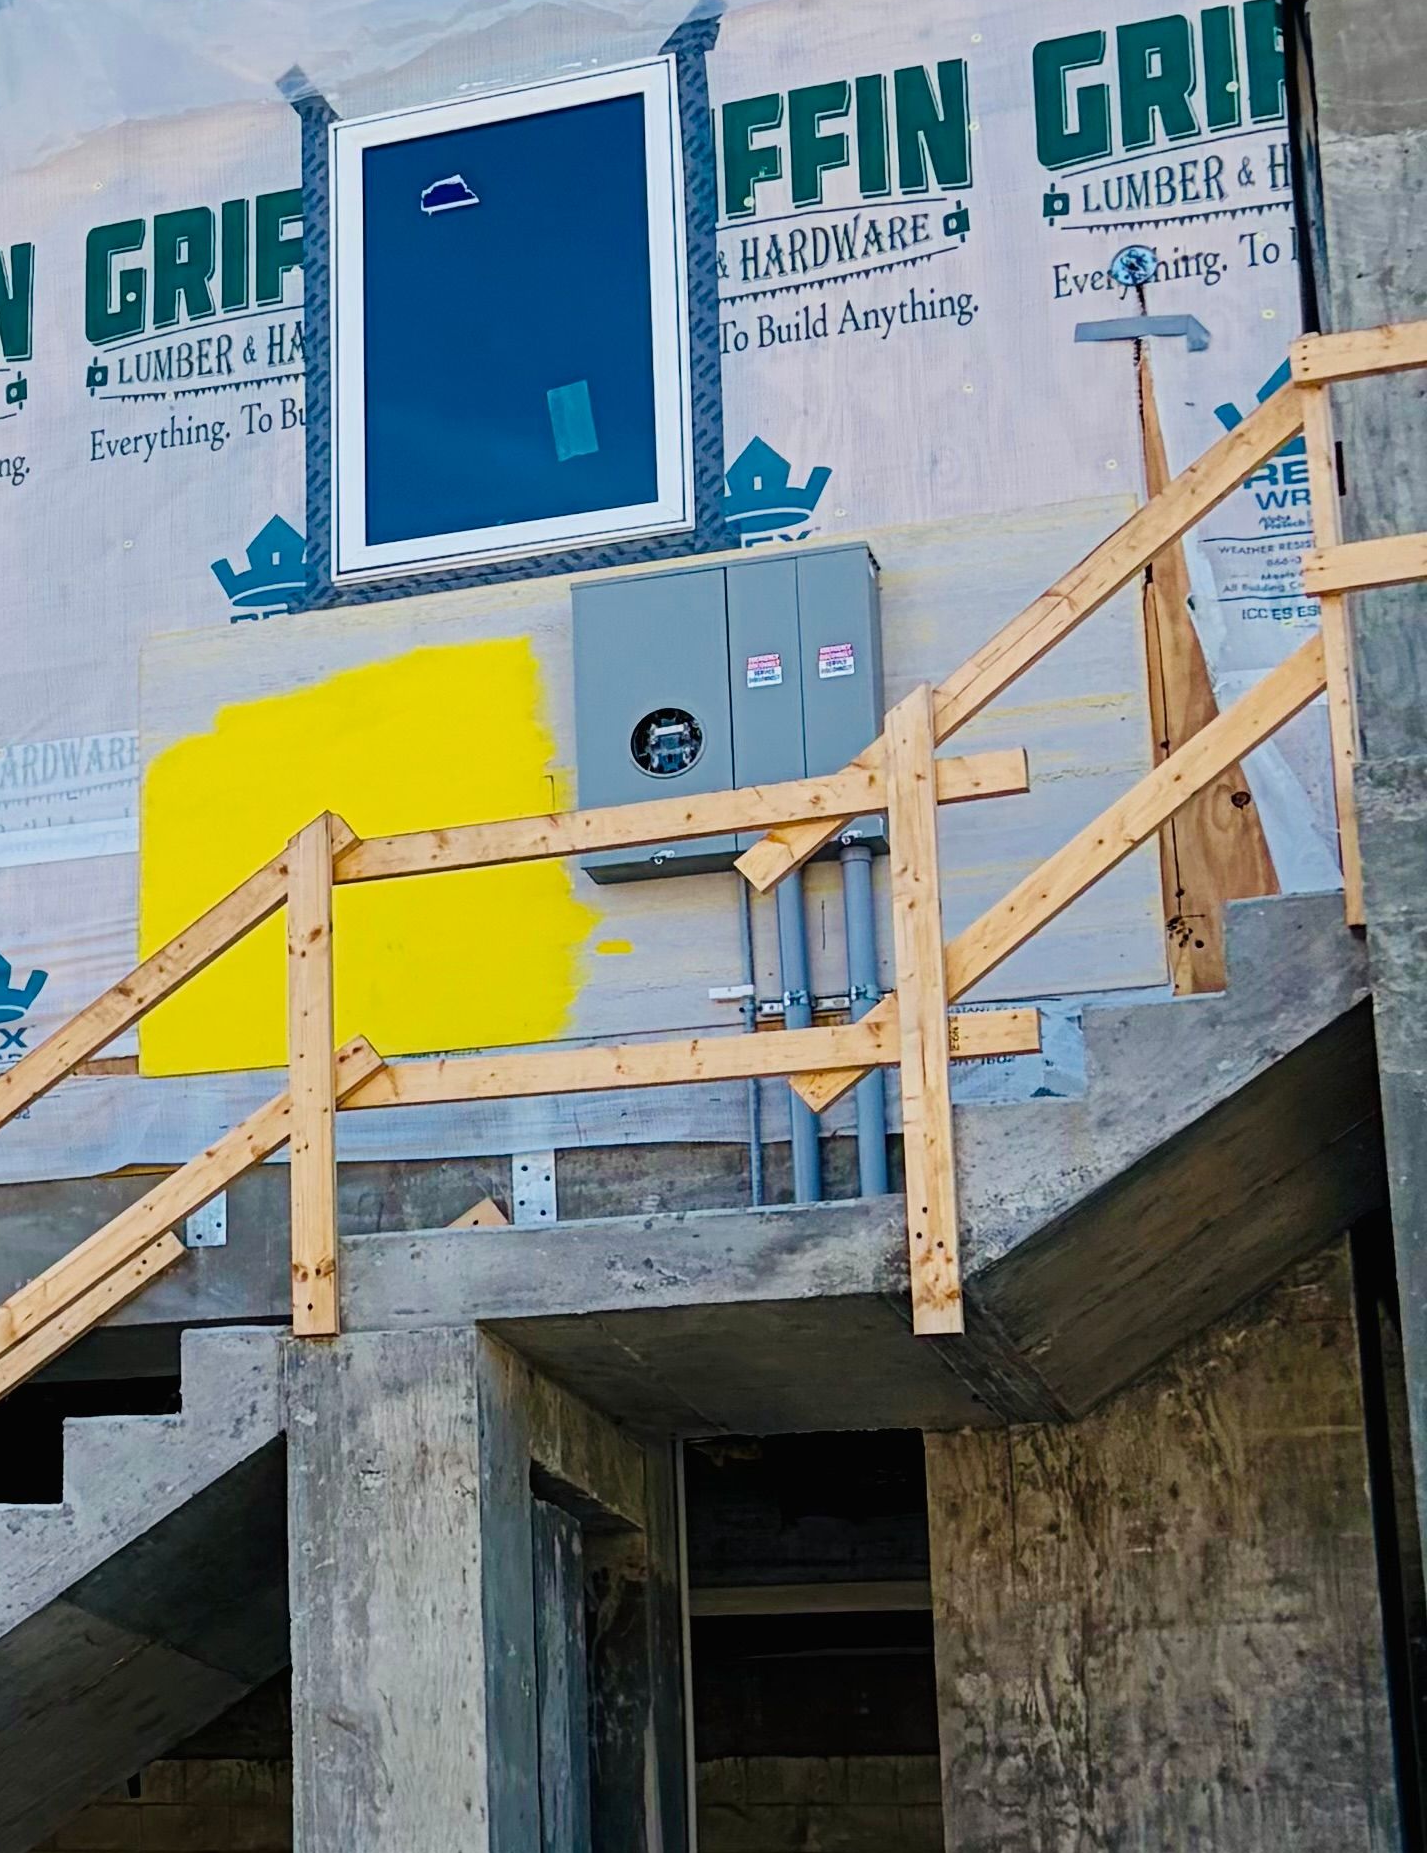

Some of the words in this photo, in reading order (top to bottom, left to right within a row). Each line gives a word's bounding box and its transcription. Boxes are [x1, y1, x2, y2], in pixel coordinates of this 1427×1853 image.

[721, 58, 973, 220] FFIN
[1082, 155, 1226, 215] LUMBER
[84, 188, 305, 346] GRIF
[739, 210, 931, 284] HARDWARE
[1053, 250, 1229, 301] Everyhing.
[1238, 232, 1281, 269] To
[757, 307, 829, 348] Build
[838, 288, 979, 337] Anything.
[117, 334, 233, 386] LUMBER
[90, 417, 232, 462] Everything.
[240, 403, 273, 438] To
[1243, 460, 1309, 489] RE
[1255, 489, 1311, 510] WR
[1242, 608, 1268, 620] ICC
